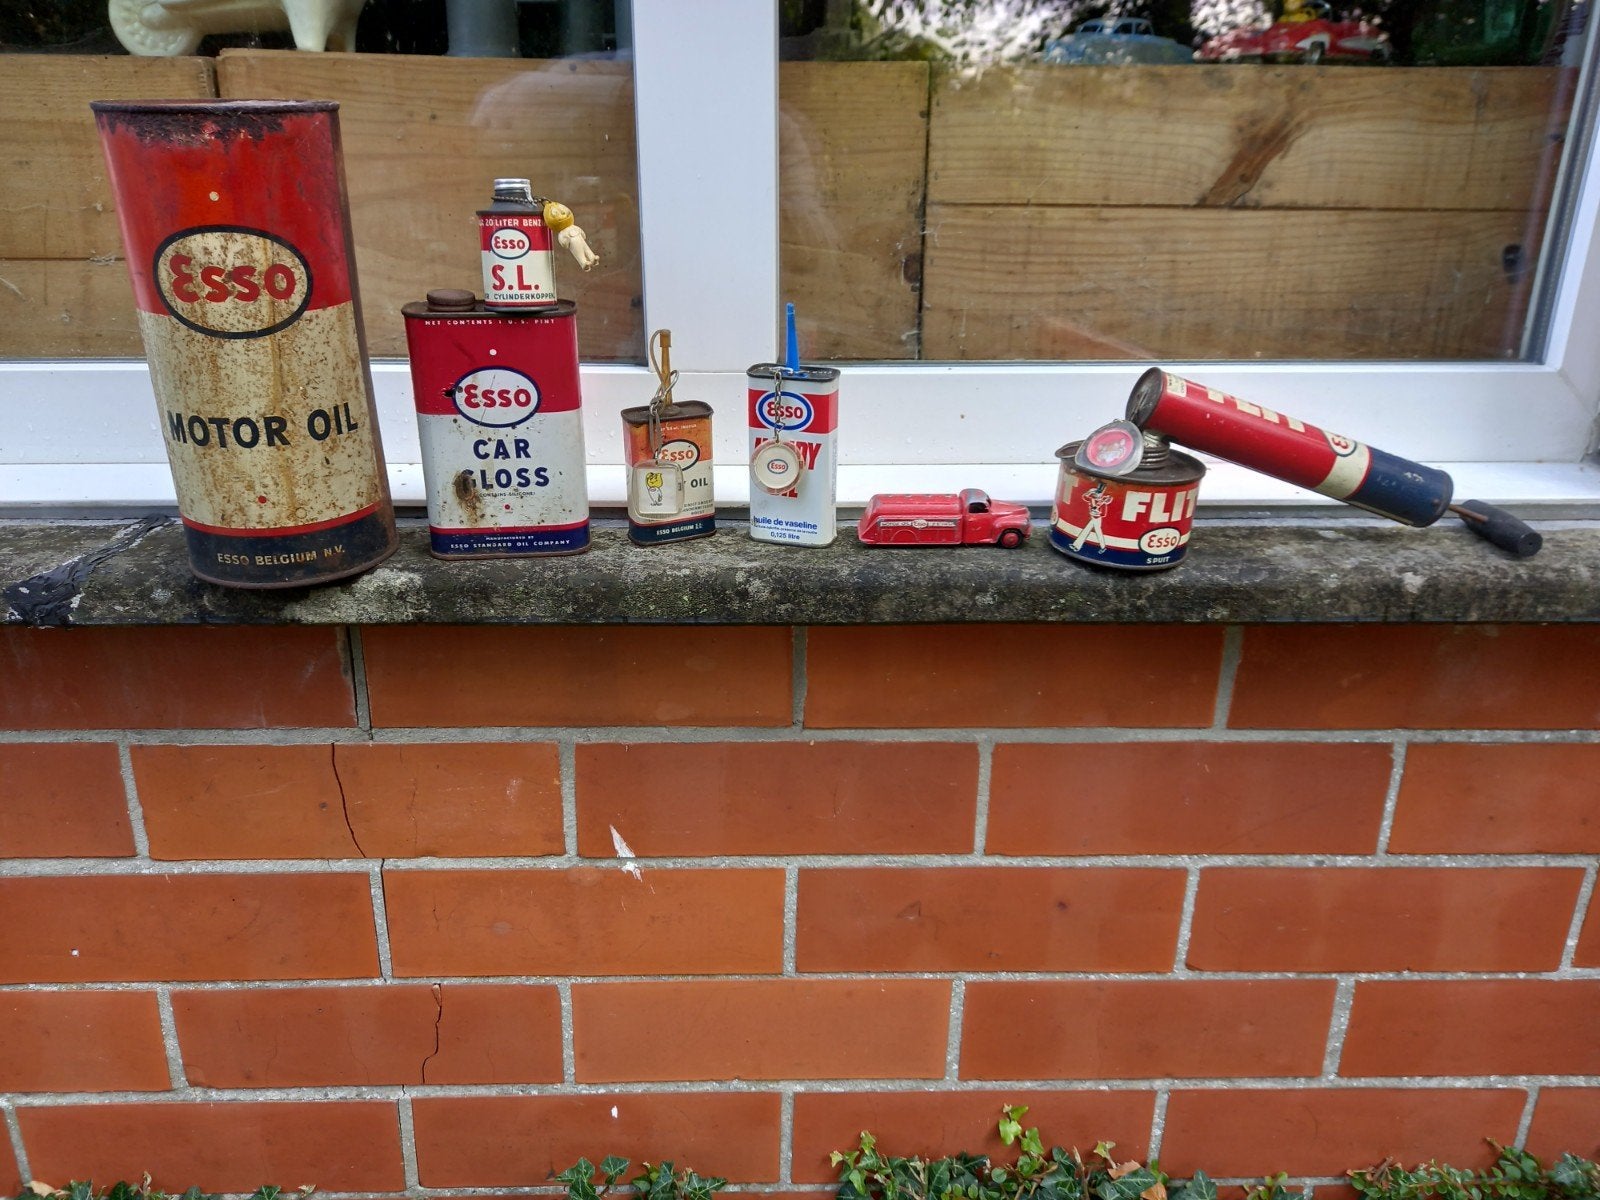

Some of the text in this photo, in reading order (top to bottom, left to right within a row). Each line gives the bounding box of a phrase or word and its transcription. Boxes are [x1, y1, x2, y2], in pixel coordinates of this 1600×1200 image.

[495, 219, 519, 227] LITER
[492, 264, 540, 291] S.L.
[167, 402, 358, 448] MOTOR OIL
[473, 439, 532, 459] CAR
[690, 478, 708, 488] OIL
[1121, 488, 1198, 523] FLIT
[754, 516, 772, 524] huile
[773, 518, 783, 526] de
[785, 520, 818, 529] vaseline
[217, 553, 249, 566] ESSO
[255, 550, 317, 565] BELGIUM
